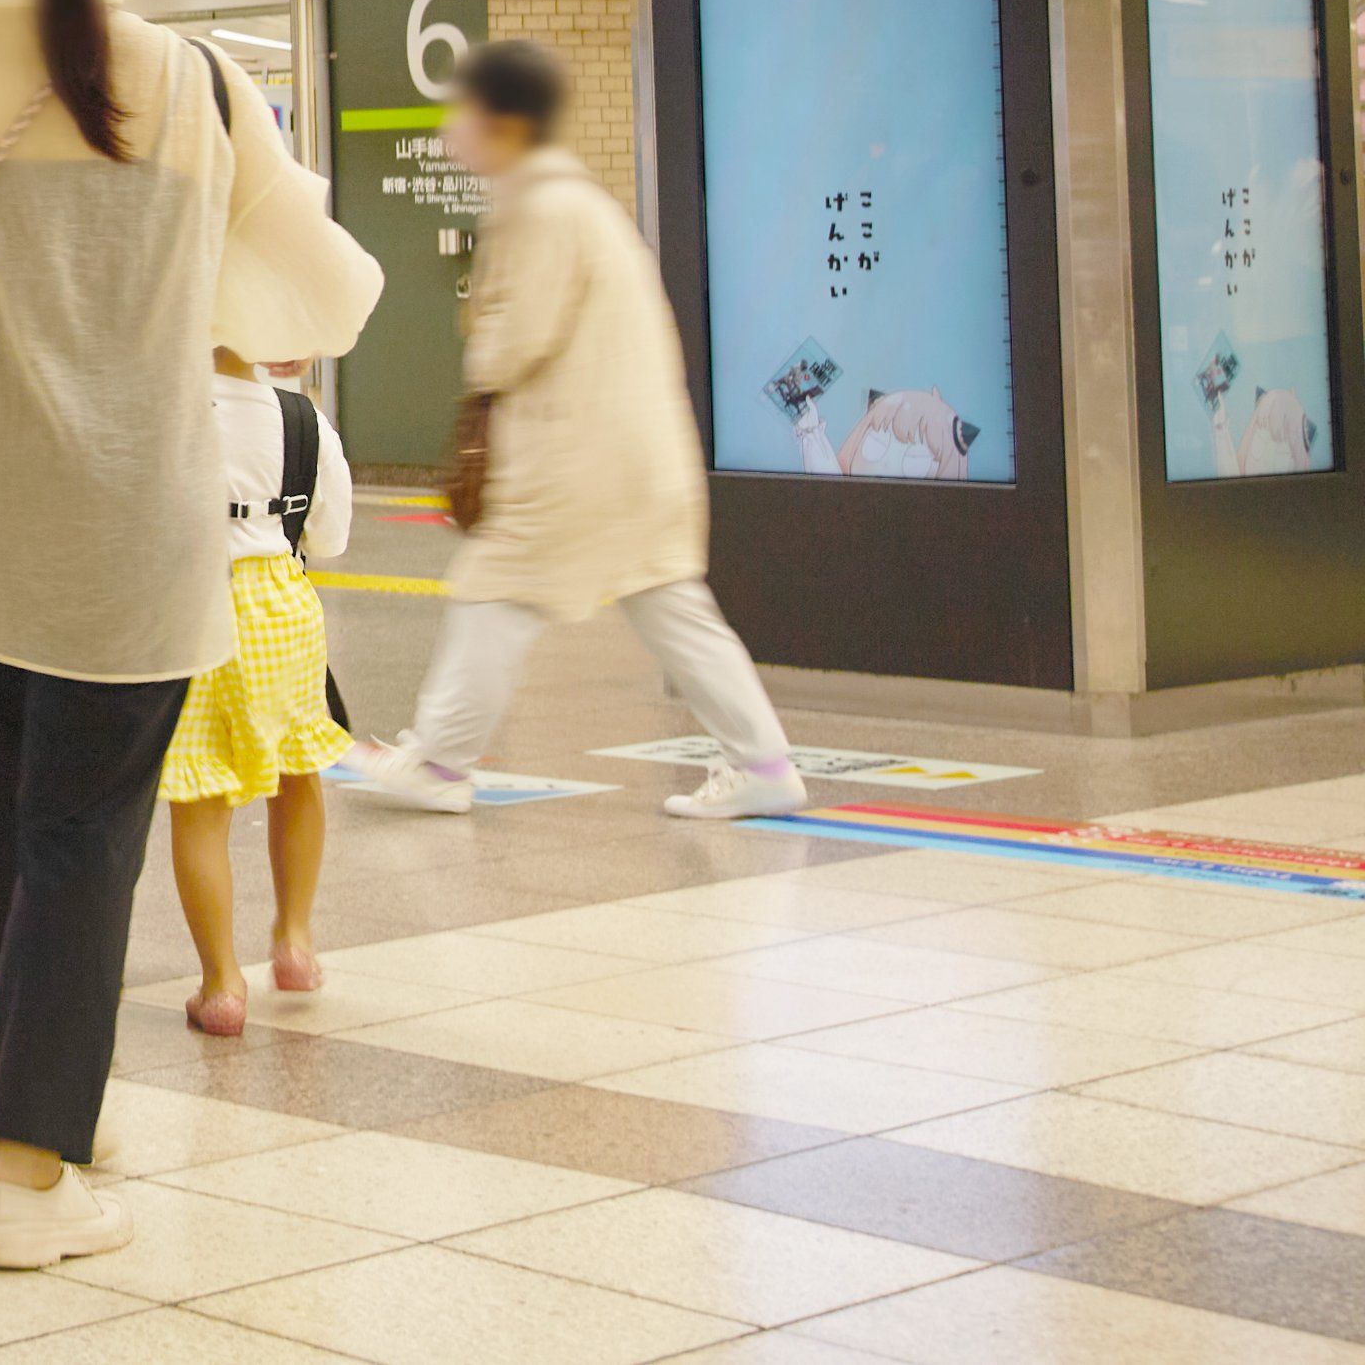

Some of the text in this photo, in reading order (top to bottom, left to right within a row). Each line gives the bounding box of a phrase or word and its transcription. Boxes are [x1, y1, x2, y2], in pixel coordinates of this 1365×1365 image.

[825, 192, 849, 298] げんかい
[858, 190, 880, 271] ここが
[1222, 187, 1238, 297] げんかい
[1242, 187, 1256, 268] ここが
